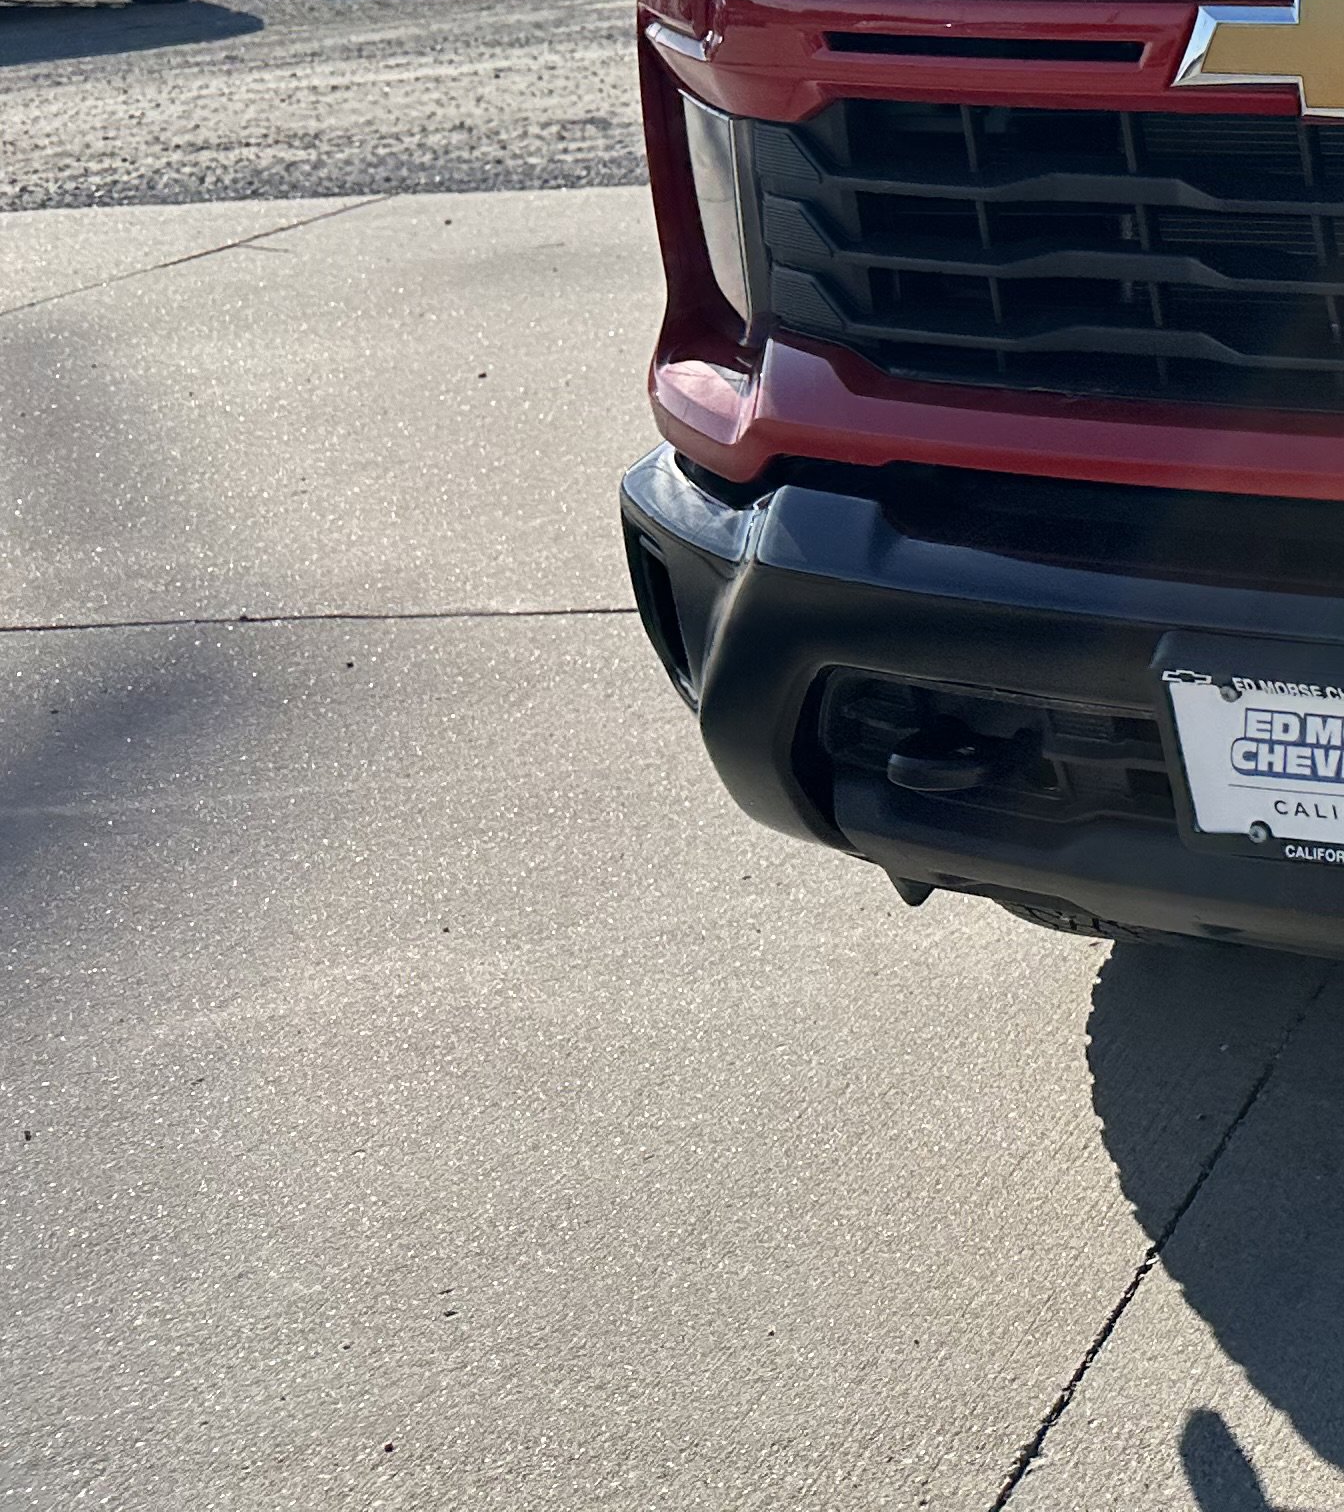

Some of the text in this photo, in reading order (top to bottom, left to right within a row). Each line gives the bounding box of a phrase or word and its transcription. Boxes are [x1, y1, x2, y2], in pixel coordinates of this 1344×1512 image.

[1232, 676, 1258, 693] ED
[1259, 679, 1323, 700] MORSE
[1245, 707, 1302, 744] ED
